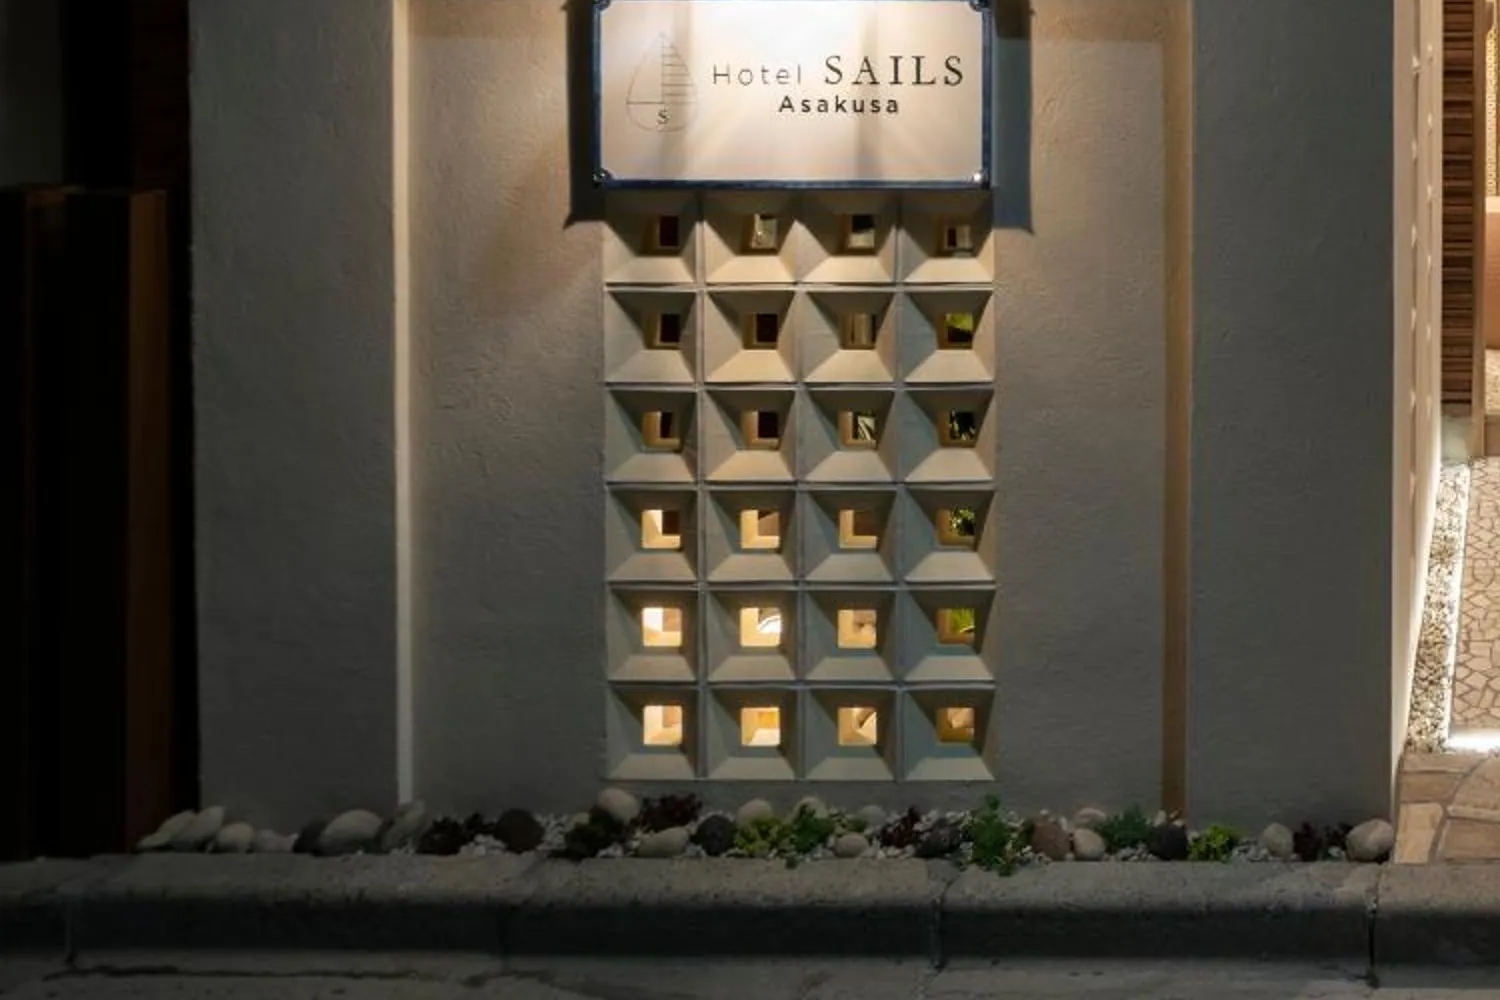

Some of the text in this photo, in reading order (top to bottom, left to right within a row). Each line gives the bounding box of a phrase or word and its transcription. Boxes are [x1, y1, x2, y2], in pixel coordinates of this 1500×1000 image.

[712, 55, 964, 87] Hotel SAILS
[778, 95, 899, 114] Asakusa
